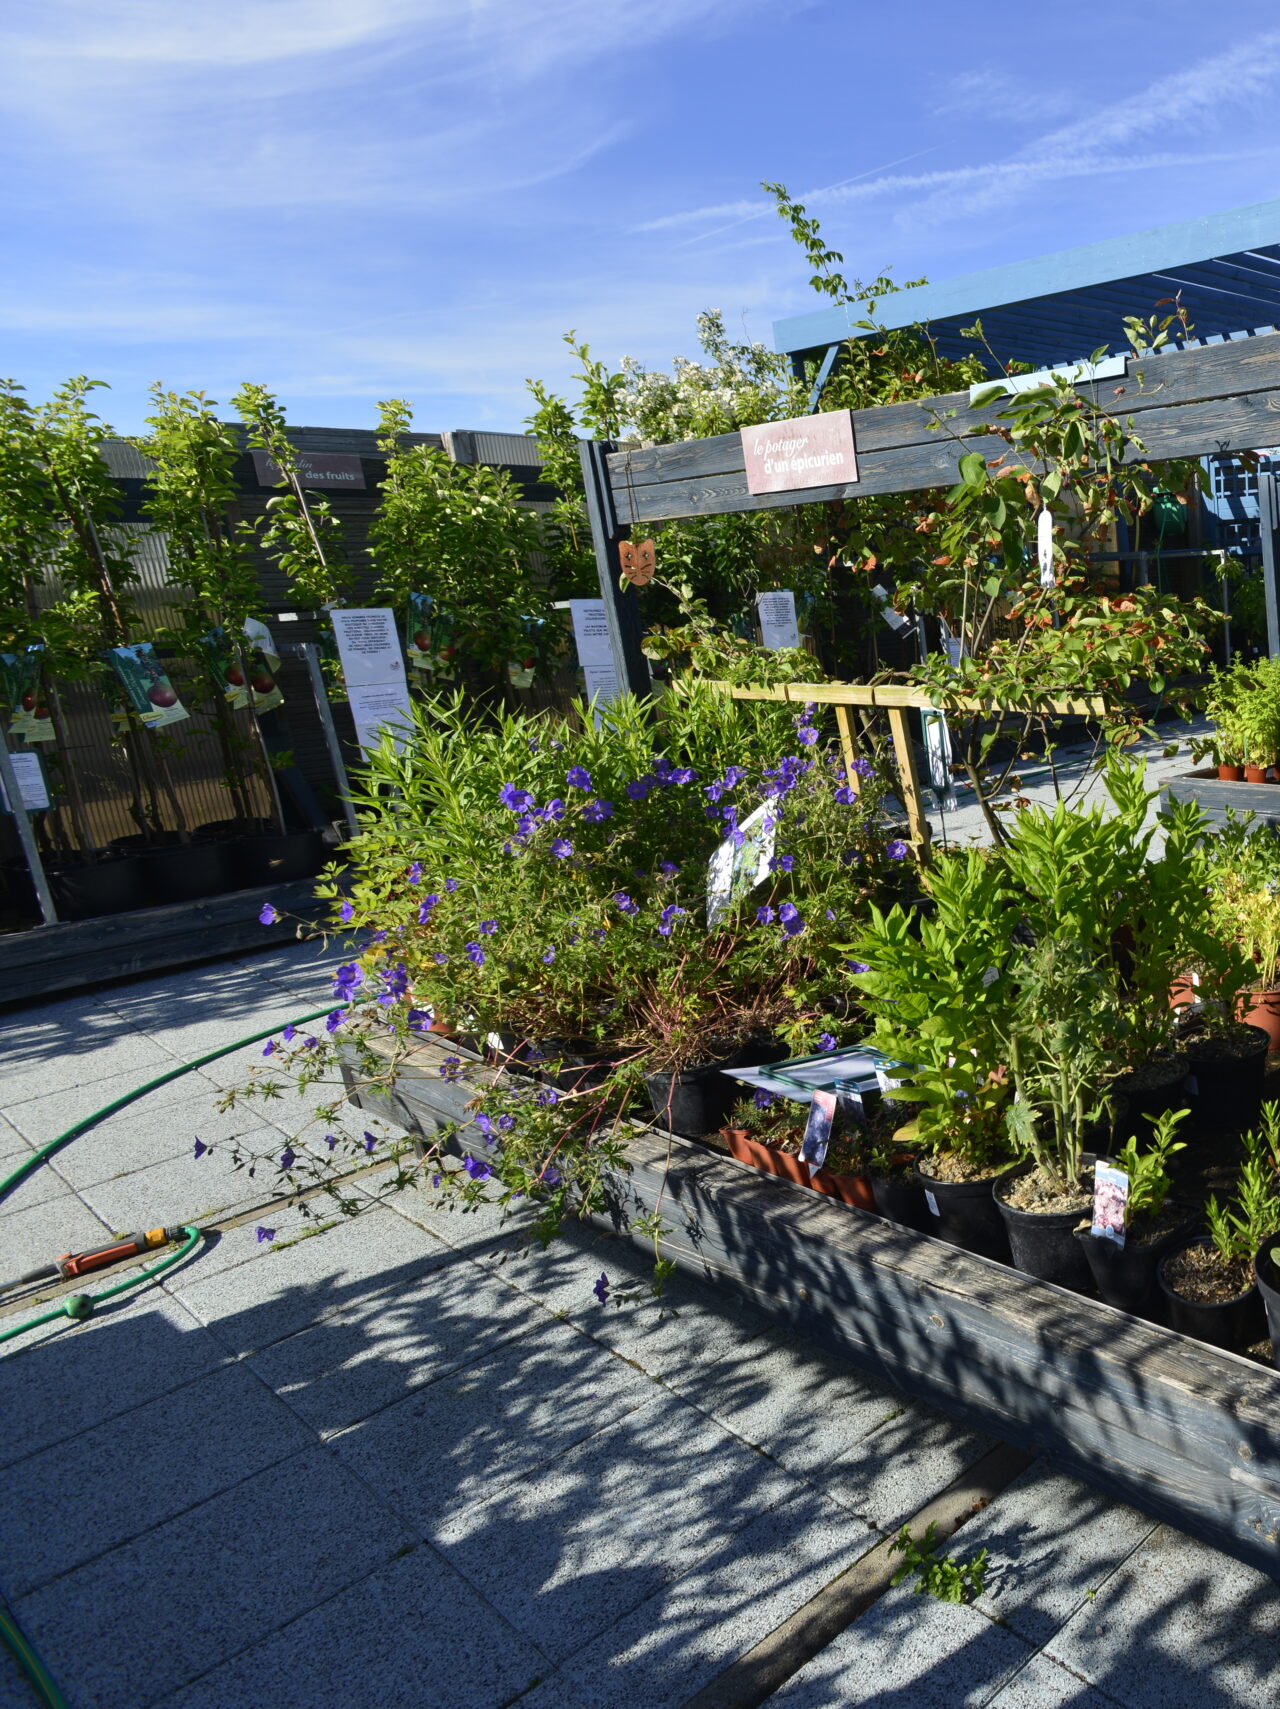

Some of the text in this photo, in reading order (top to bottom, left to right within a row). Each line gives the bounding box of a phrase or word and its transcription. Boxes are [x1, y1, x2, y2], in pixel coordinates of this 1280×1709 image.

[753, 437, 809, 461] le potager
[764, 450, 845, 475] d'un épicurien
[305, 470, 355, 481] des fruits
